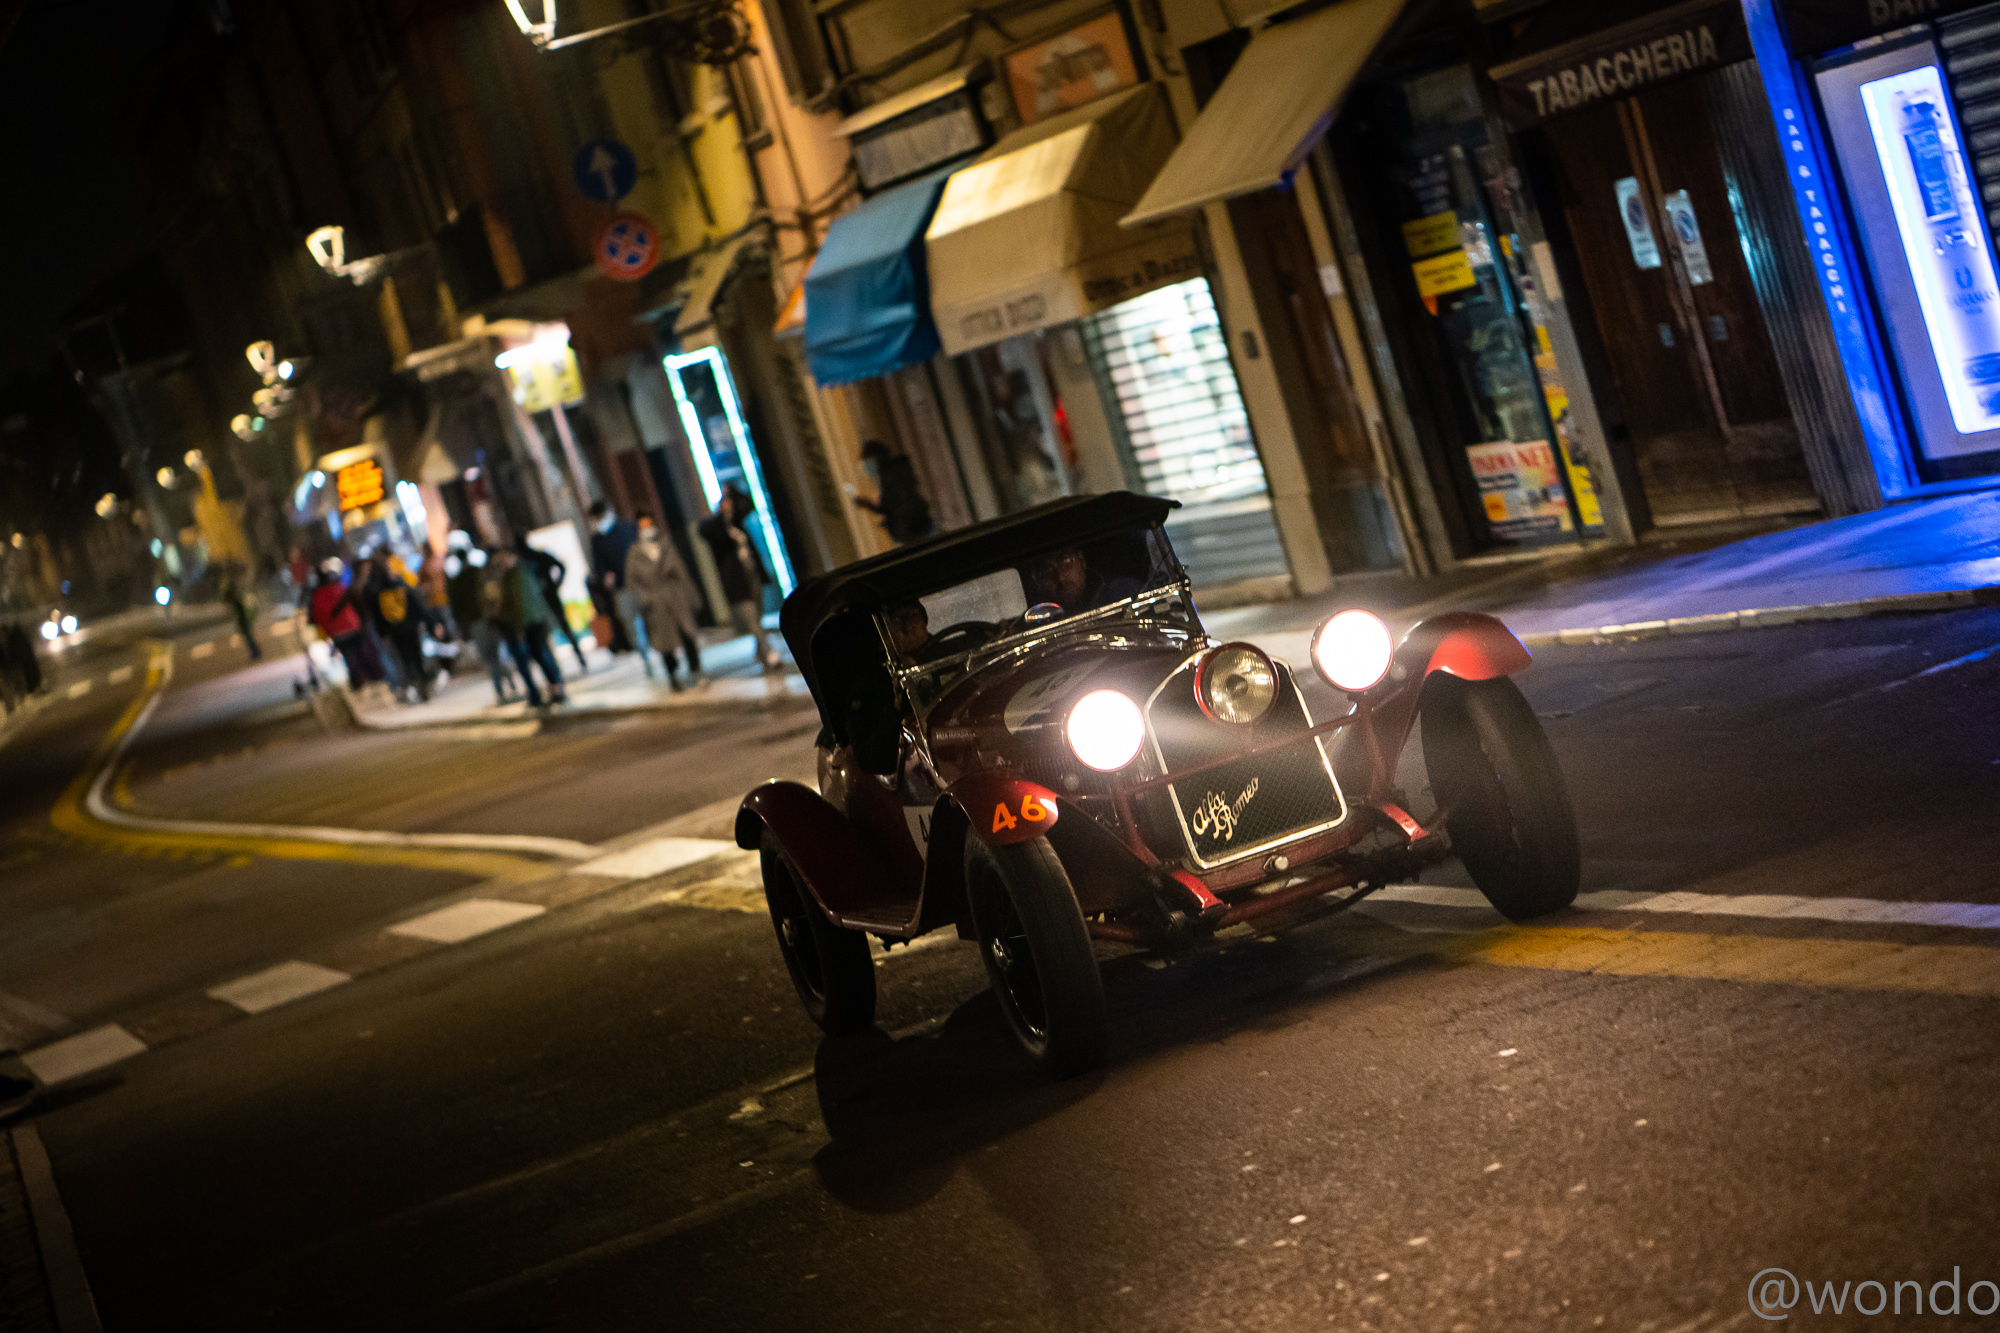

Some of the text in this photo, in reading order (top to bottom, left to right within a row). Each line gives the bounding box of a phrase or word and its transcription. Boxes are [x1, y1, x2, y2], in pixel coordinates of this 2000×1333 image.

[1527, 25, 1719, 117] TABACCHERIA
[1783, 108, 1804, 152] BAR
[1805, 189, 1847, 314] TABACCHI
[992, 795, 1047, 834] 46
[1193, 777, 1258, 841] Alfa Romeo
